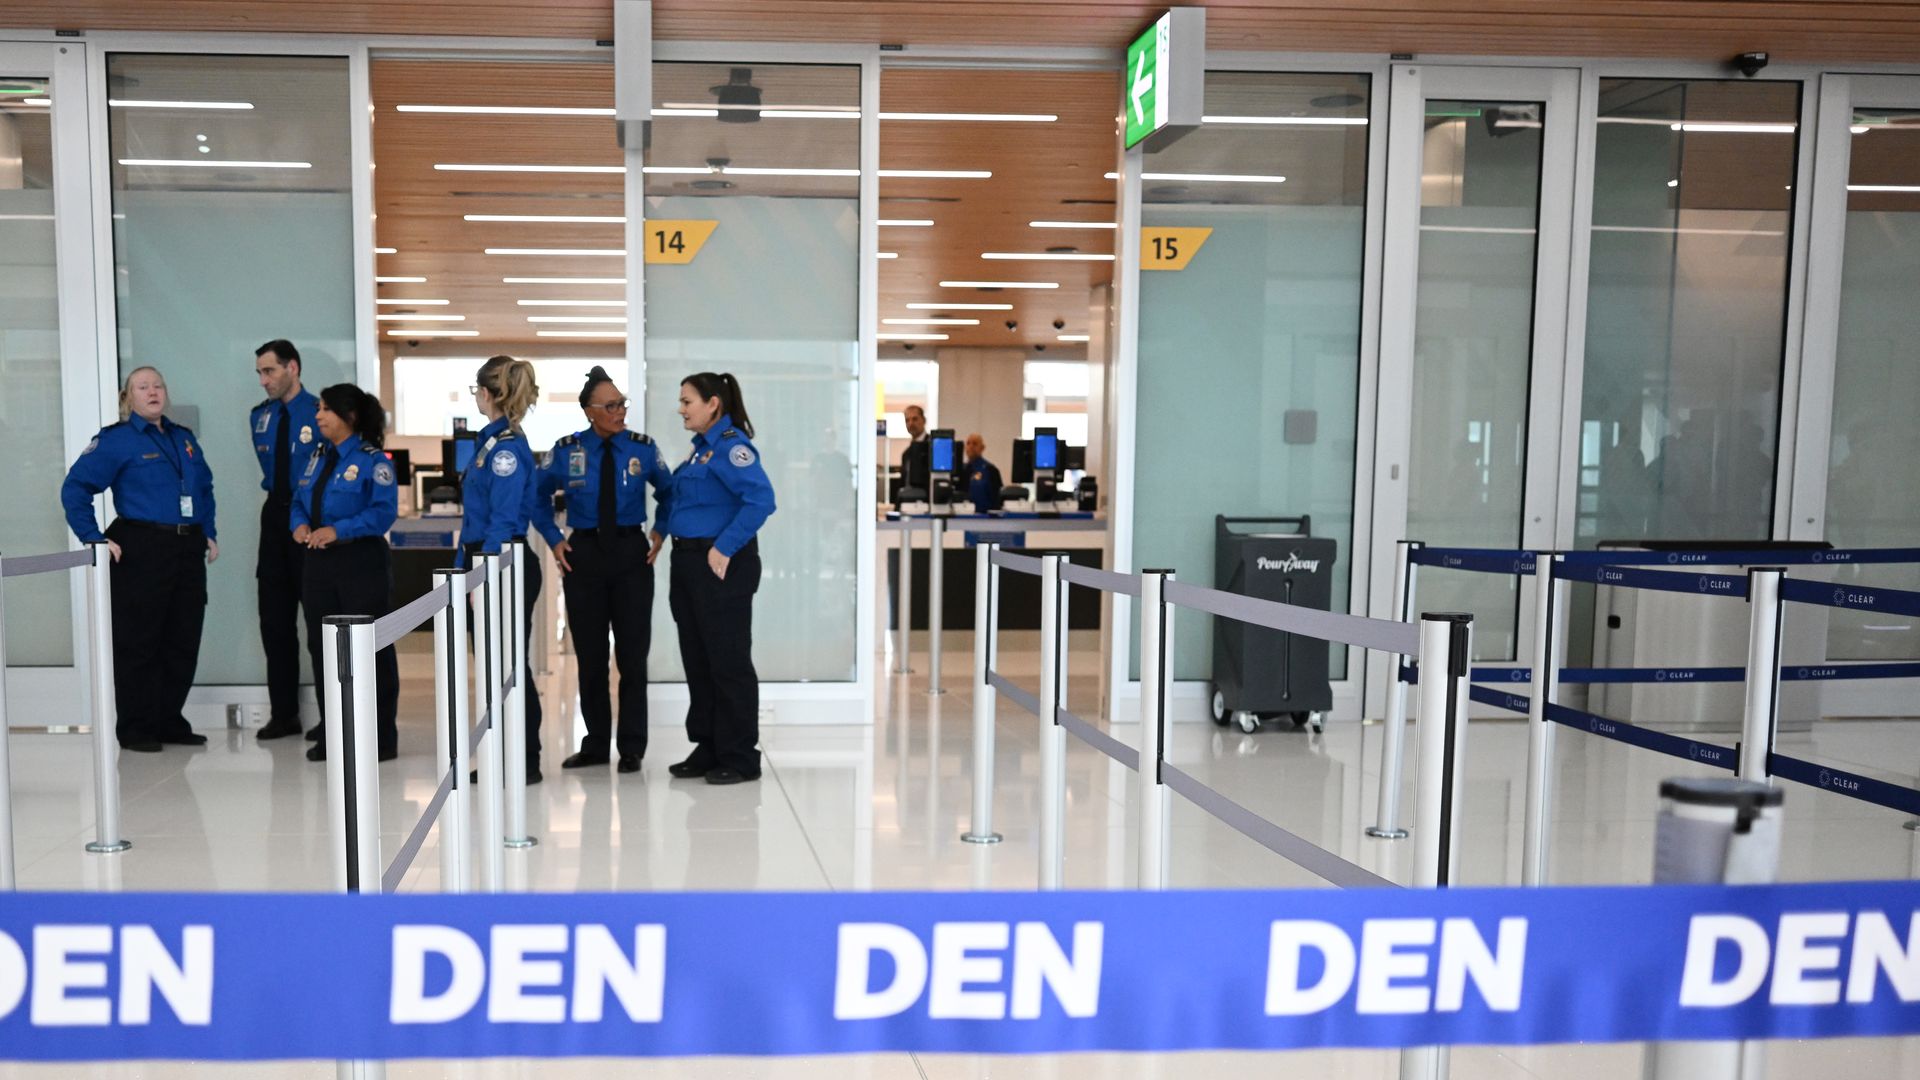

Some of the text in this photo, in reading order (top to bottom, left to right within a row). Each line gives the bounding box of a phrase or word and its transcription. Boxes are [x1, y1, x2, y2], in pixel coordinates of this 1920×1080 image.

[655, 231, 686, 254] 14
[1152, 237, 1178, 260] 15
[1682, 554, 1706, 562] CLEAR
[1826, 552, 1850, 561] CLEAR
[1521, 562, 1535, 571] CLEAR
[1606, 570, 1622, 580] CLEAR
[1710, 580, 1731, 590] CLEAR
[1848, 593, 1874, 605] CLEAR
[1669, 671, 1694, 679] CLEAR
[1812, 669, 1836, 677] CLEAR
[1700, 748, 1721, 761] CLEAR
[1833, 776, 1859, 791] CLEAR
[1680, 910, 1920, 1007] DEN
[834, 921, 1104, 1020] DEN
[1265, 917, 1528, 1016] DEN
[0, 925, 213, 1026] EN
[390, 924, 666, 1024] DEN
